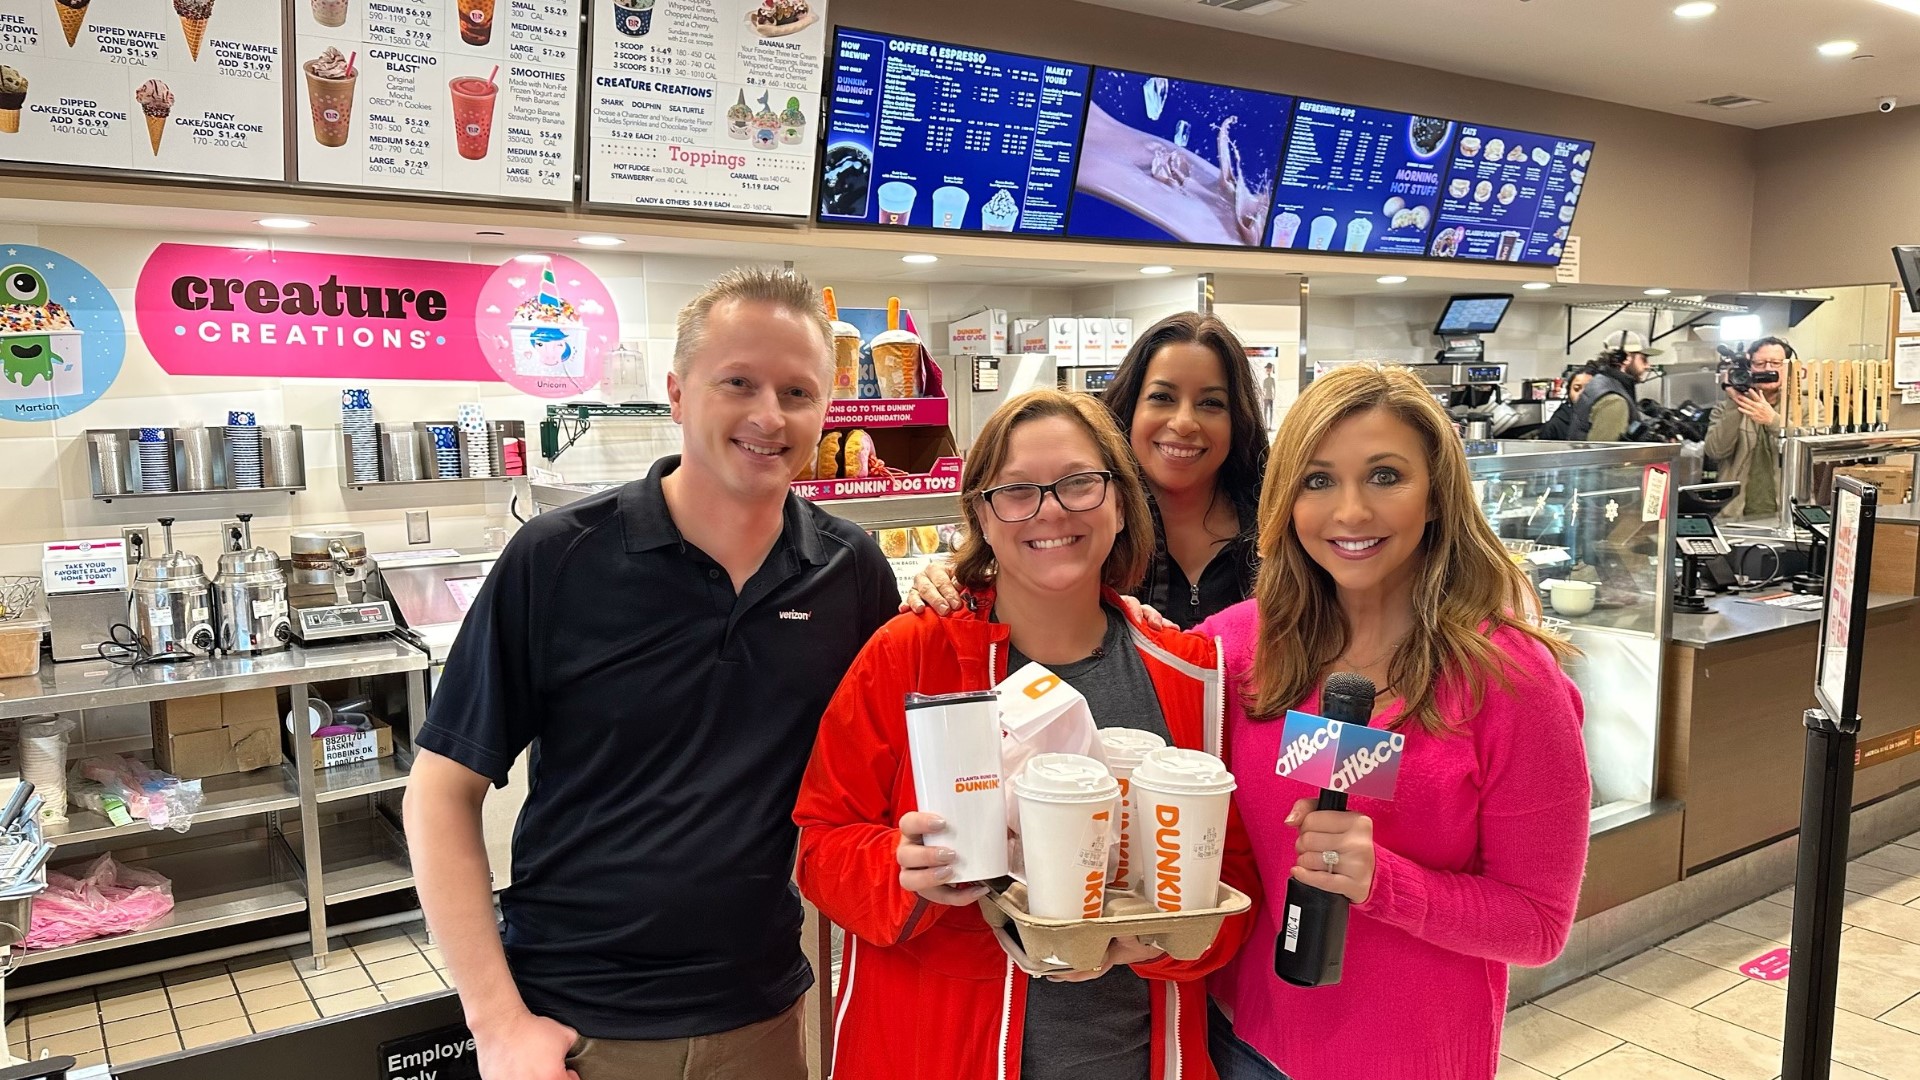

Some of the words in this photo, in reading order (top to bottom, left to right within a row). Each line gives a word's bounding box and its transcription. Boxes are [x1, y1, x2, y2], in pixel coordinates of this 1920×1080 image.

[370, 4, 403, 14] MEDIUM
[406, 8, 432, 18] $6.99
[89, 25, 125, 36] DIPPED
[127, 29, 166, 41] WAFFLE
[369, 25, 396, 35] LARGE
[406, 29, 431, 39] $7.99
[3, 34, 37, 45] $1.19
[97, 35, 159, 49] CONE/BOWL
[759, 40, 785, 49] BANANA
[841, 41, 860, 50] NOW
[100, 45, 122, 54] ADD
[127, 48, 157, 58] $1.59
[210, 40, 240, 52] FANCY
[242, 43, 278, 54] WAFFLE
[620, 42, 644, 50] SCOOP
[889, 39, 928, 55] COFFEE
[930, 46, 937, 57] &
[939, 48, 986, 64] ESPRESSO
[216, 49, 273, 63] CONE/BOWL
[370, 49, 437, 66] CAPPUCCINO
[620, 53, 647, 61] SCOOPS
[218, 59, 239, 68] ADD
[243, 61, 271, 71] $1.99
[620, 62, 646, 71] SCOOPS
[1046, 66, 1063, 76] MAKE
[1065, 68, 1072, 76] IT
[511, 68, 565, 81] SMOOTHIES
[1045, 75, 1067, 85] YOURS
[596, 77, 651, 91] CREATURE
[837, 76, 867, 86] DUNKIN'
[386, 83, 415, 93] Caramel
[836, 84, 873, 95] MIDNIGHT
[389, 91, 413, 100] Mocha
[60, 98, 97, 108] DIPPED
[601, 98, 624, 106] SHARK
[632, 101, 661, 110] DOLPHIN
[669, 104, 681, 112] SEA
[683, 106, 704, 114] TURTLE
[30, 105, 96, 118] CAKE/SUGAR
[98, 110, 127, 120] CONE
[1299, 102, 1339, 116] REFRESHING
[1340, 108, 1355, 118] SIPS
[50, 116, 73, 125] ADD
[78, 117, 109, 127] $0.99
[204, 111, 235, 122] FANCY
[369, 114, 395, 123] SMALL
[405, 117, 429, 127] $5.29
[176, 118, 236, 131] CAKE/SUGAR
[237, 123, 263, 133] CONE
[1462, 127, 1476, 136] EATS
[193, 128, 214, 137] ADD
[218, 130, 246, 140] $1.49
[508, 127, 531, 136] SMALL
[540, 130, 562, 140] $5.49
[612, 130, 633, 139] $5.29
[369, 135, 403, 145] MEDIUM
[405, 138, 429, 148] $6.29
[369, 157, 395, 166] LARGE
[404, 159, 429, 169] $7.29
[669, 146, 746, 169] Toppings
[614, 163, 627, 171] HOT
[628, 164, 650, 172] FUDGE
[611, 173, 654, 182] STRAWBERRY
[1396, 169, 1439, 184] MORNING,
[1390, 183, 1409, 193] HOT
[1411, 184, 1437, 195] STUFF
[665, 198, 690, 206] OTHERS
[693, 200, 712, 208] $0.99
[171, 274, 447, 321] creature
[537, 380, 567, 390] Unicorn
[15, 402, 59, 413] Martian
[864, 414, 912, 422] FOUNDATION.
[835, 480, 890, 495] DUNKIN'
[893, 479, 921, 491] DOG
[924, 477, 956, 489] TOYS
[779, 609, 808, 620] verizon
[325, 732, 367, 745] 88201701
[327, 742, 354, 751] BASKIN
[1276, 719, 1343, 777] atl&co
[327, 749, 360, 760] ROBBINS
[1330, 732, 1404, 792] atl&co
[955, 779, 999, 792] DUNKIN'
[1288, 923, 1298, 940] MIC
